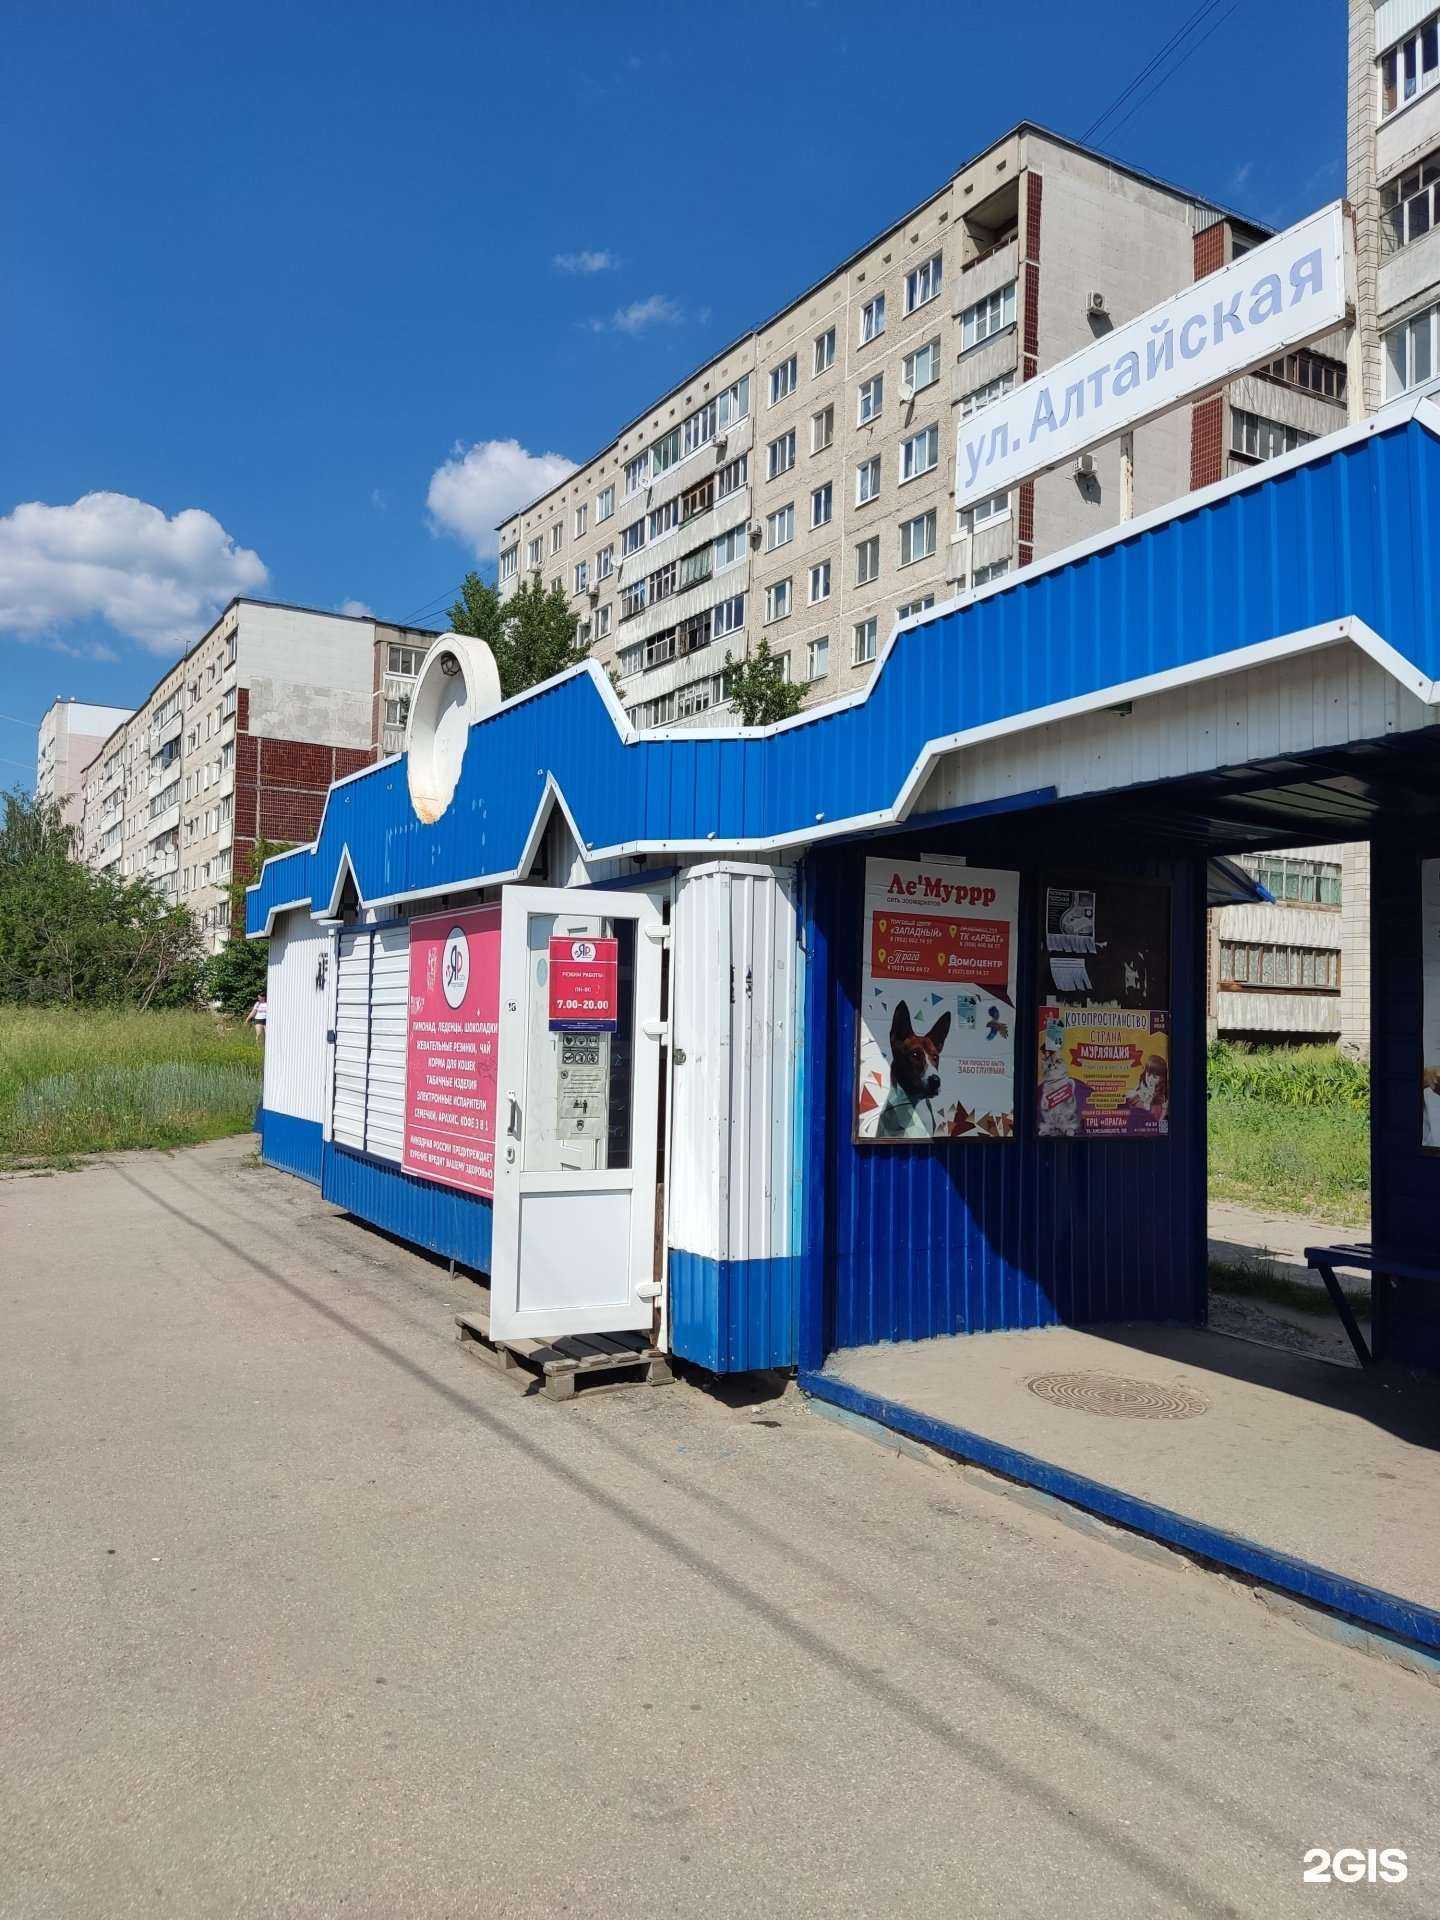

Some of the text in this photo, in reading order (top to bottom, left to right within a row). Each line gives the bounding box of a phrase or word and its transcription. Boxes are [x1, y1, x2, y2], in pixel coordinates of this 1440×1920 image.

[965, 248, 1324, 488] ул. Алтайская
[960, 932, 969, 941] ТК
[557, 1000, 609, 1010] 7.00-20.00
[1065, 1011, 1148, 1029] КОТОПРОСТРАНСТВО
[1090, 1030, 1122, 1043] СТРАНА
[480, 1041, 491, 1055] ЧАЙ
[428, 1058, 476, 1072] КОРМА ДЛЯ КОШЕК
[426, 1074, 477, 1091] ТАБАЧНЫЕ ИЗДЕЛИЯ
[416, 1090, 487, 1111] ЭЛЕКТРОННЫЕ ИСПАРИТЕЛИ
[460, 1116, 474, 1128] КОФЕ
